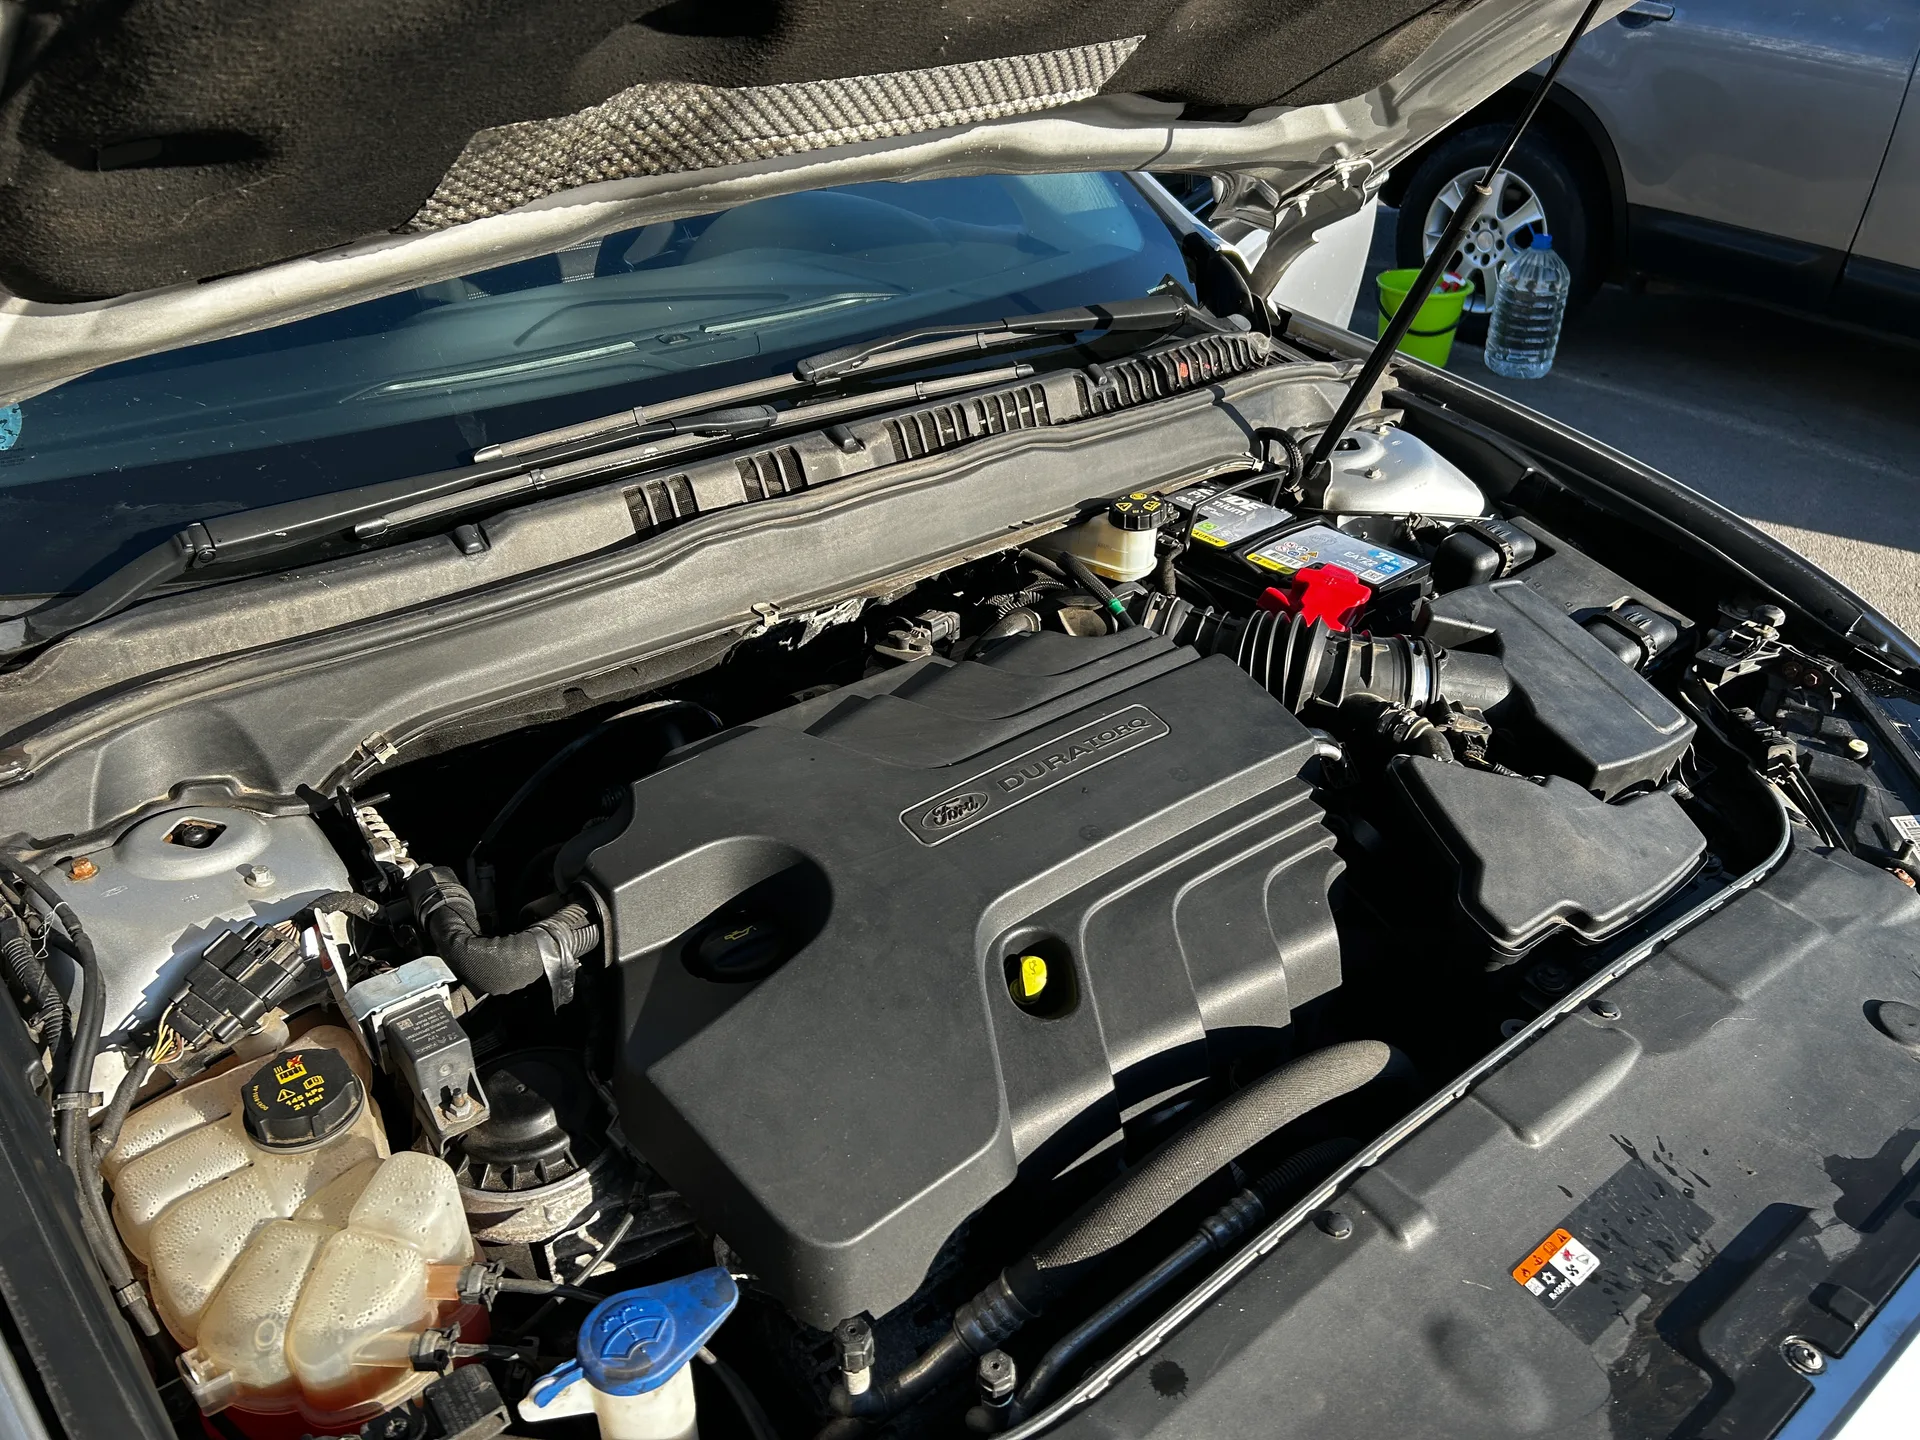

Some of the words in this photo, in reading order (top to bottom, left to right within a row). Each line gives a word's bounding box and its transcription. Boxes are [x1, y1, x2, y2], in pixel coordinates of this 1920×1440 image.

[1186, 490, 1247, 516] Prmium
[1197, 488, 1265, 513] EIDE
[1343, 551, 1378, 567] EA722
[1376, 552, 1395, 562] 72
[932, 796, 979, 826] Ford
[997, 717, 1151, 792] DURATORQ
[285, 1095, 304, 1106] 145
[305, 1087, 325, 1098] kPa
[293, 1101, 306, 1111] 21
[308, 1094, 323, 1106] psi
